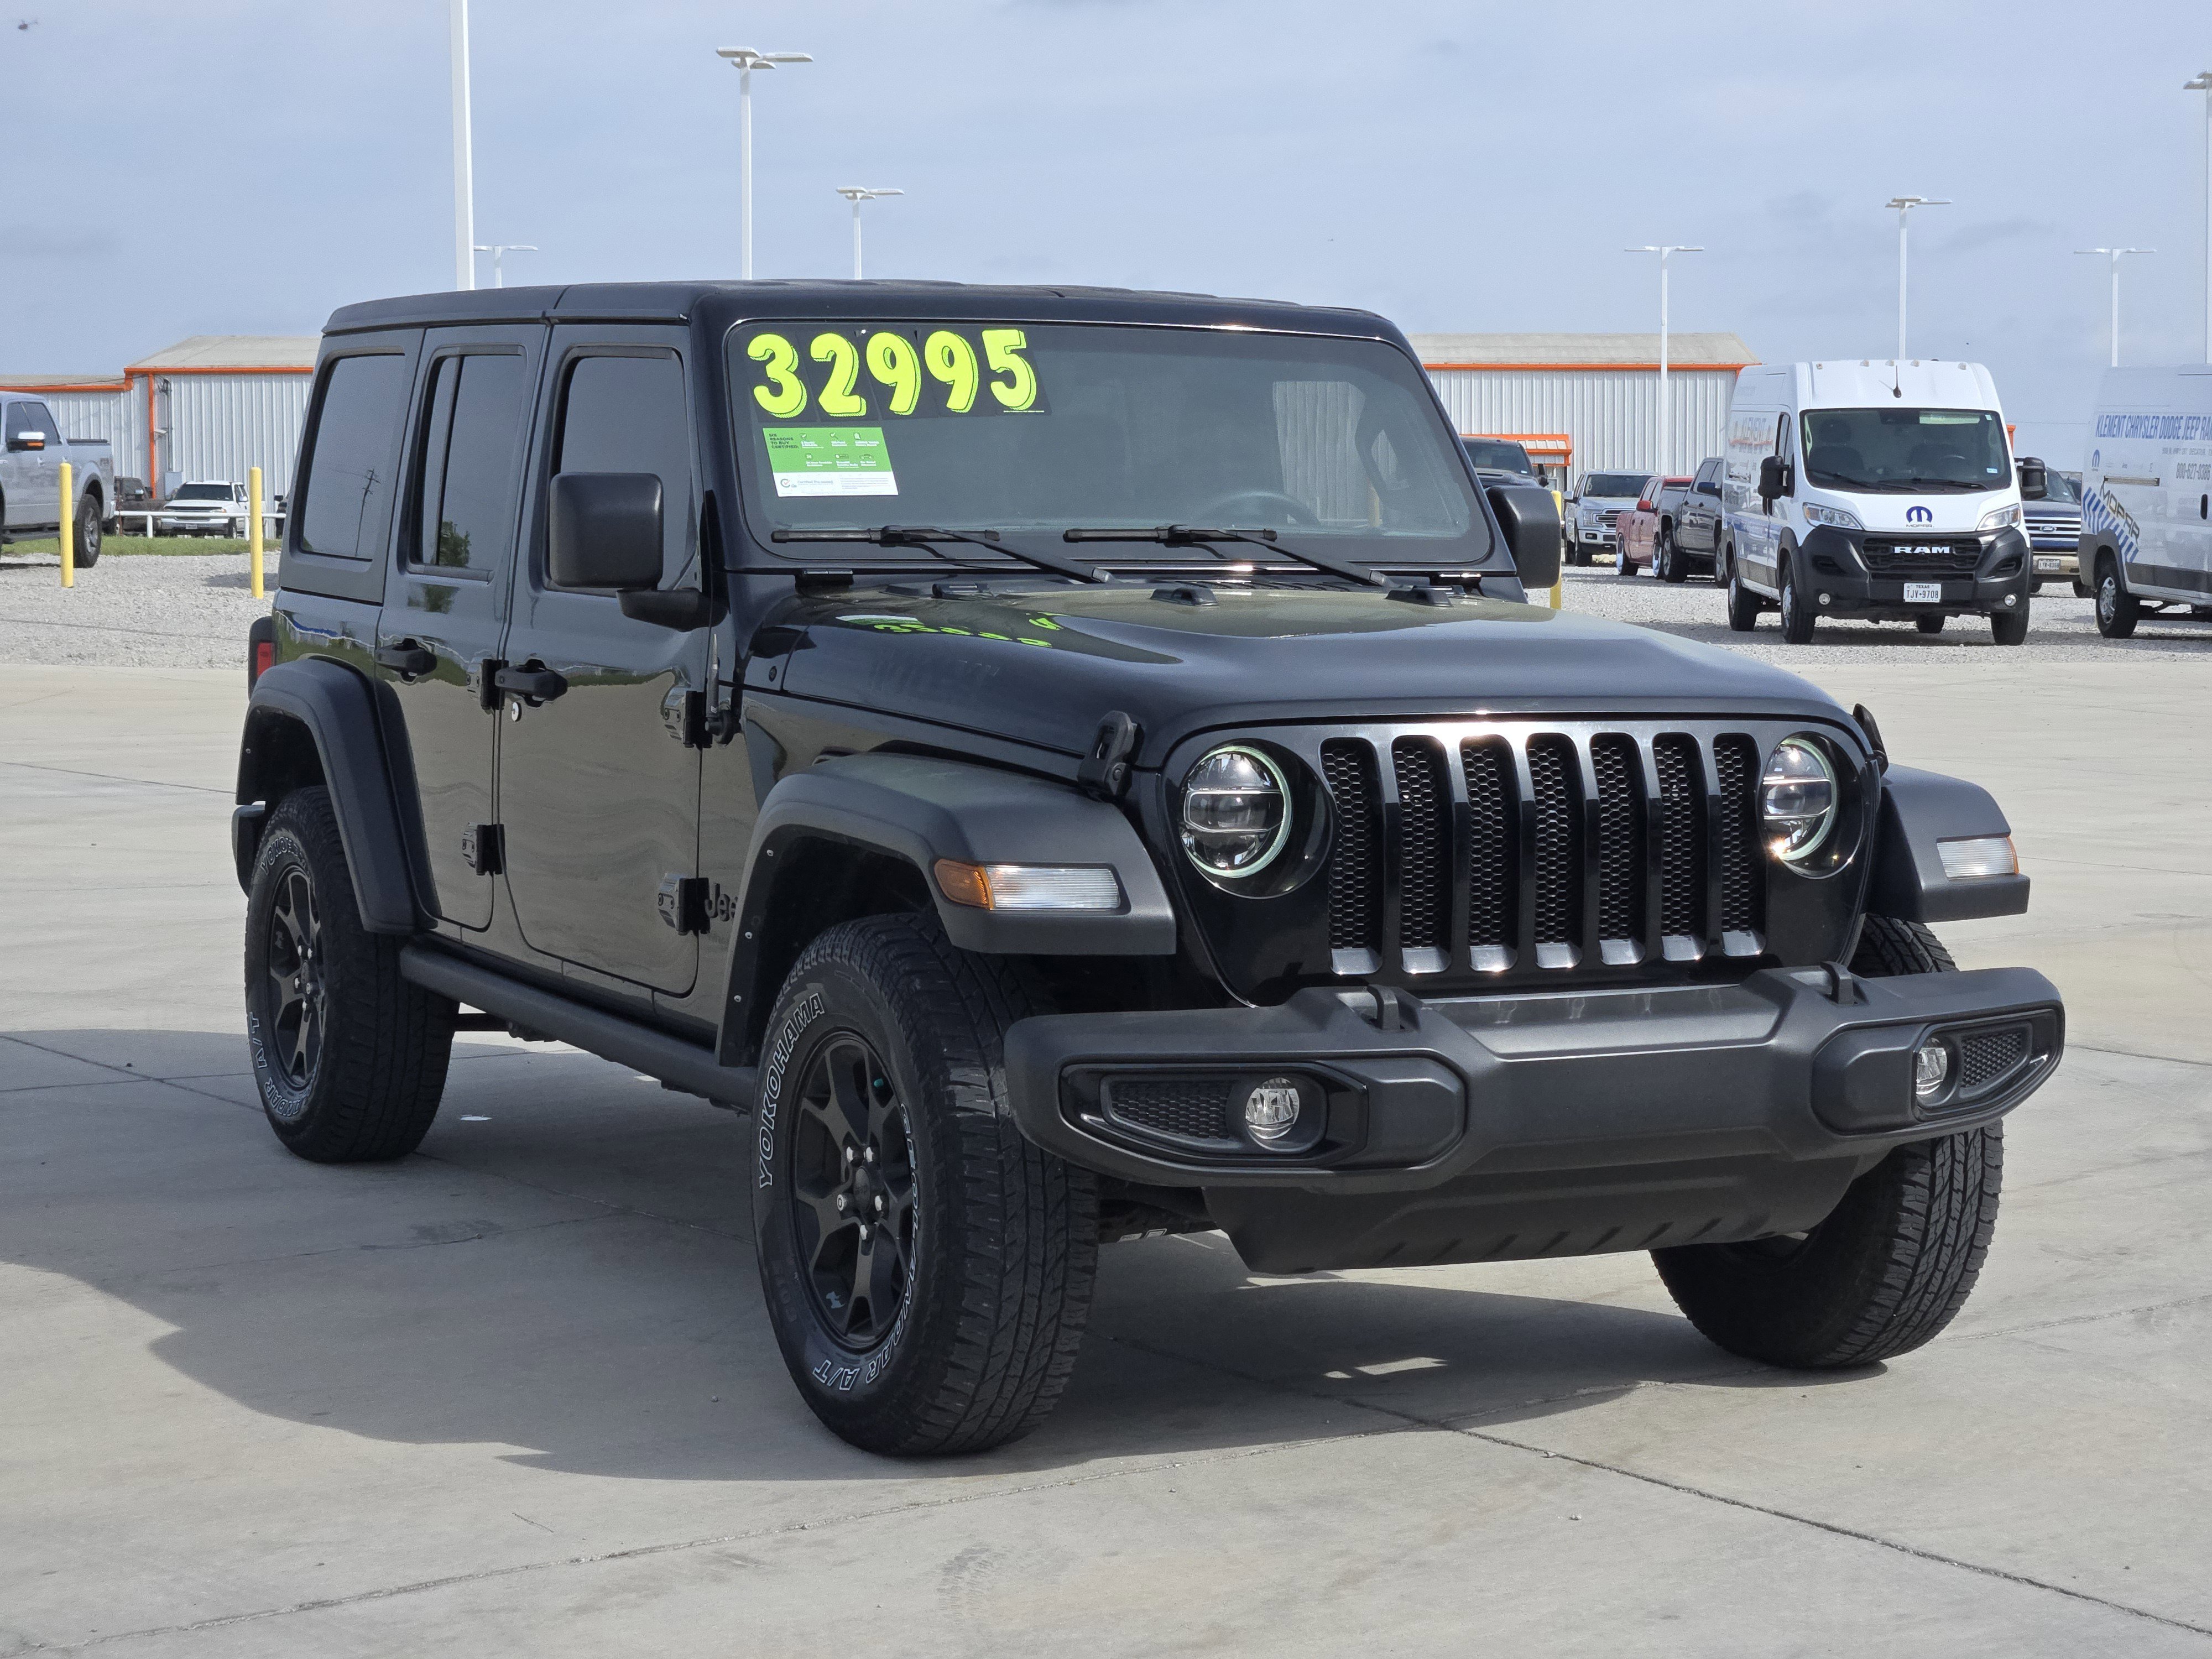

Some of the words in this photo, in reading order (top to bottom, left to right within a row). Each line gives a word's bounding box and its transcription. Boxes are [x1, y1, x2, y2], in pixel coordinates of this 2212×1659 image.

[748, 329, 1037, 419] 32995
[2095, 415, 2127, 438] KLEMENT
[2125, 415, 2160, 439] CHRYSLER
[2158, 416, 2184, 440] DODGE
[2182, 416, 2201, 440] JEEP
[2100, 479, 2140, 547] MOPAR
[758, 992, 825, 1188] YOKOHAMA
[812, 1359, 860, 1391] A/T
